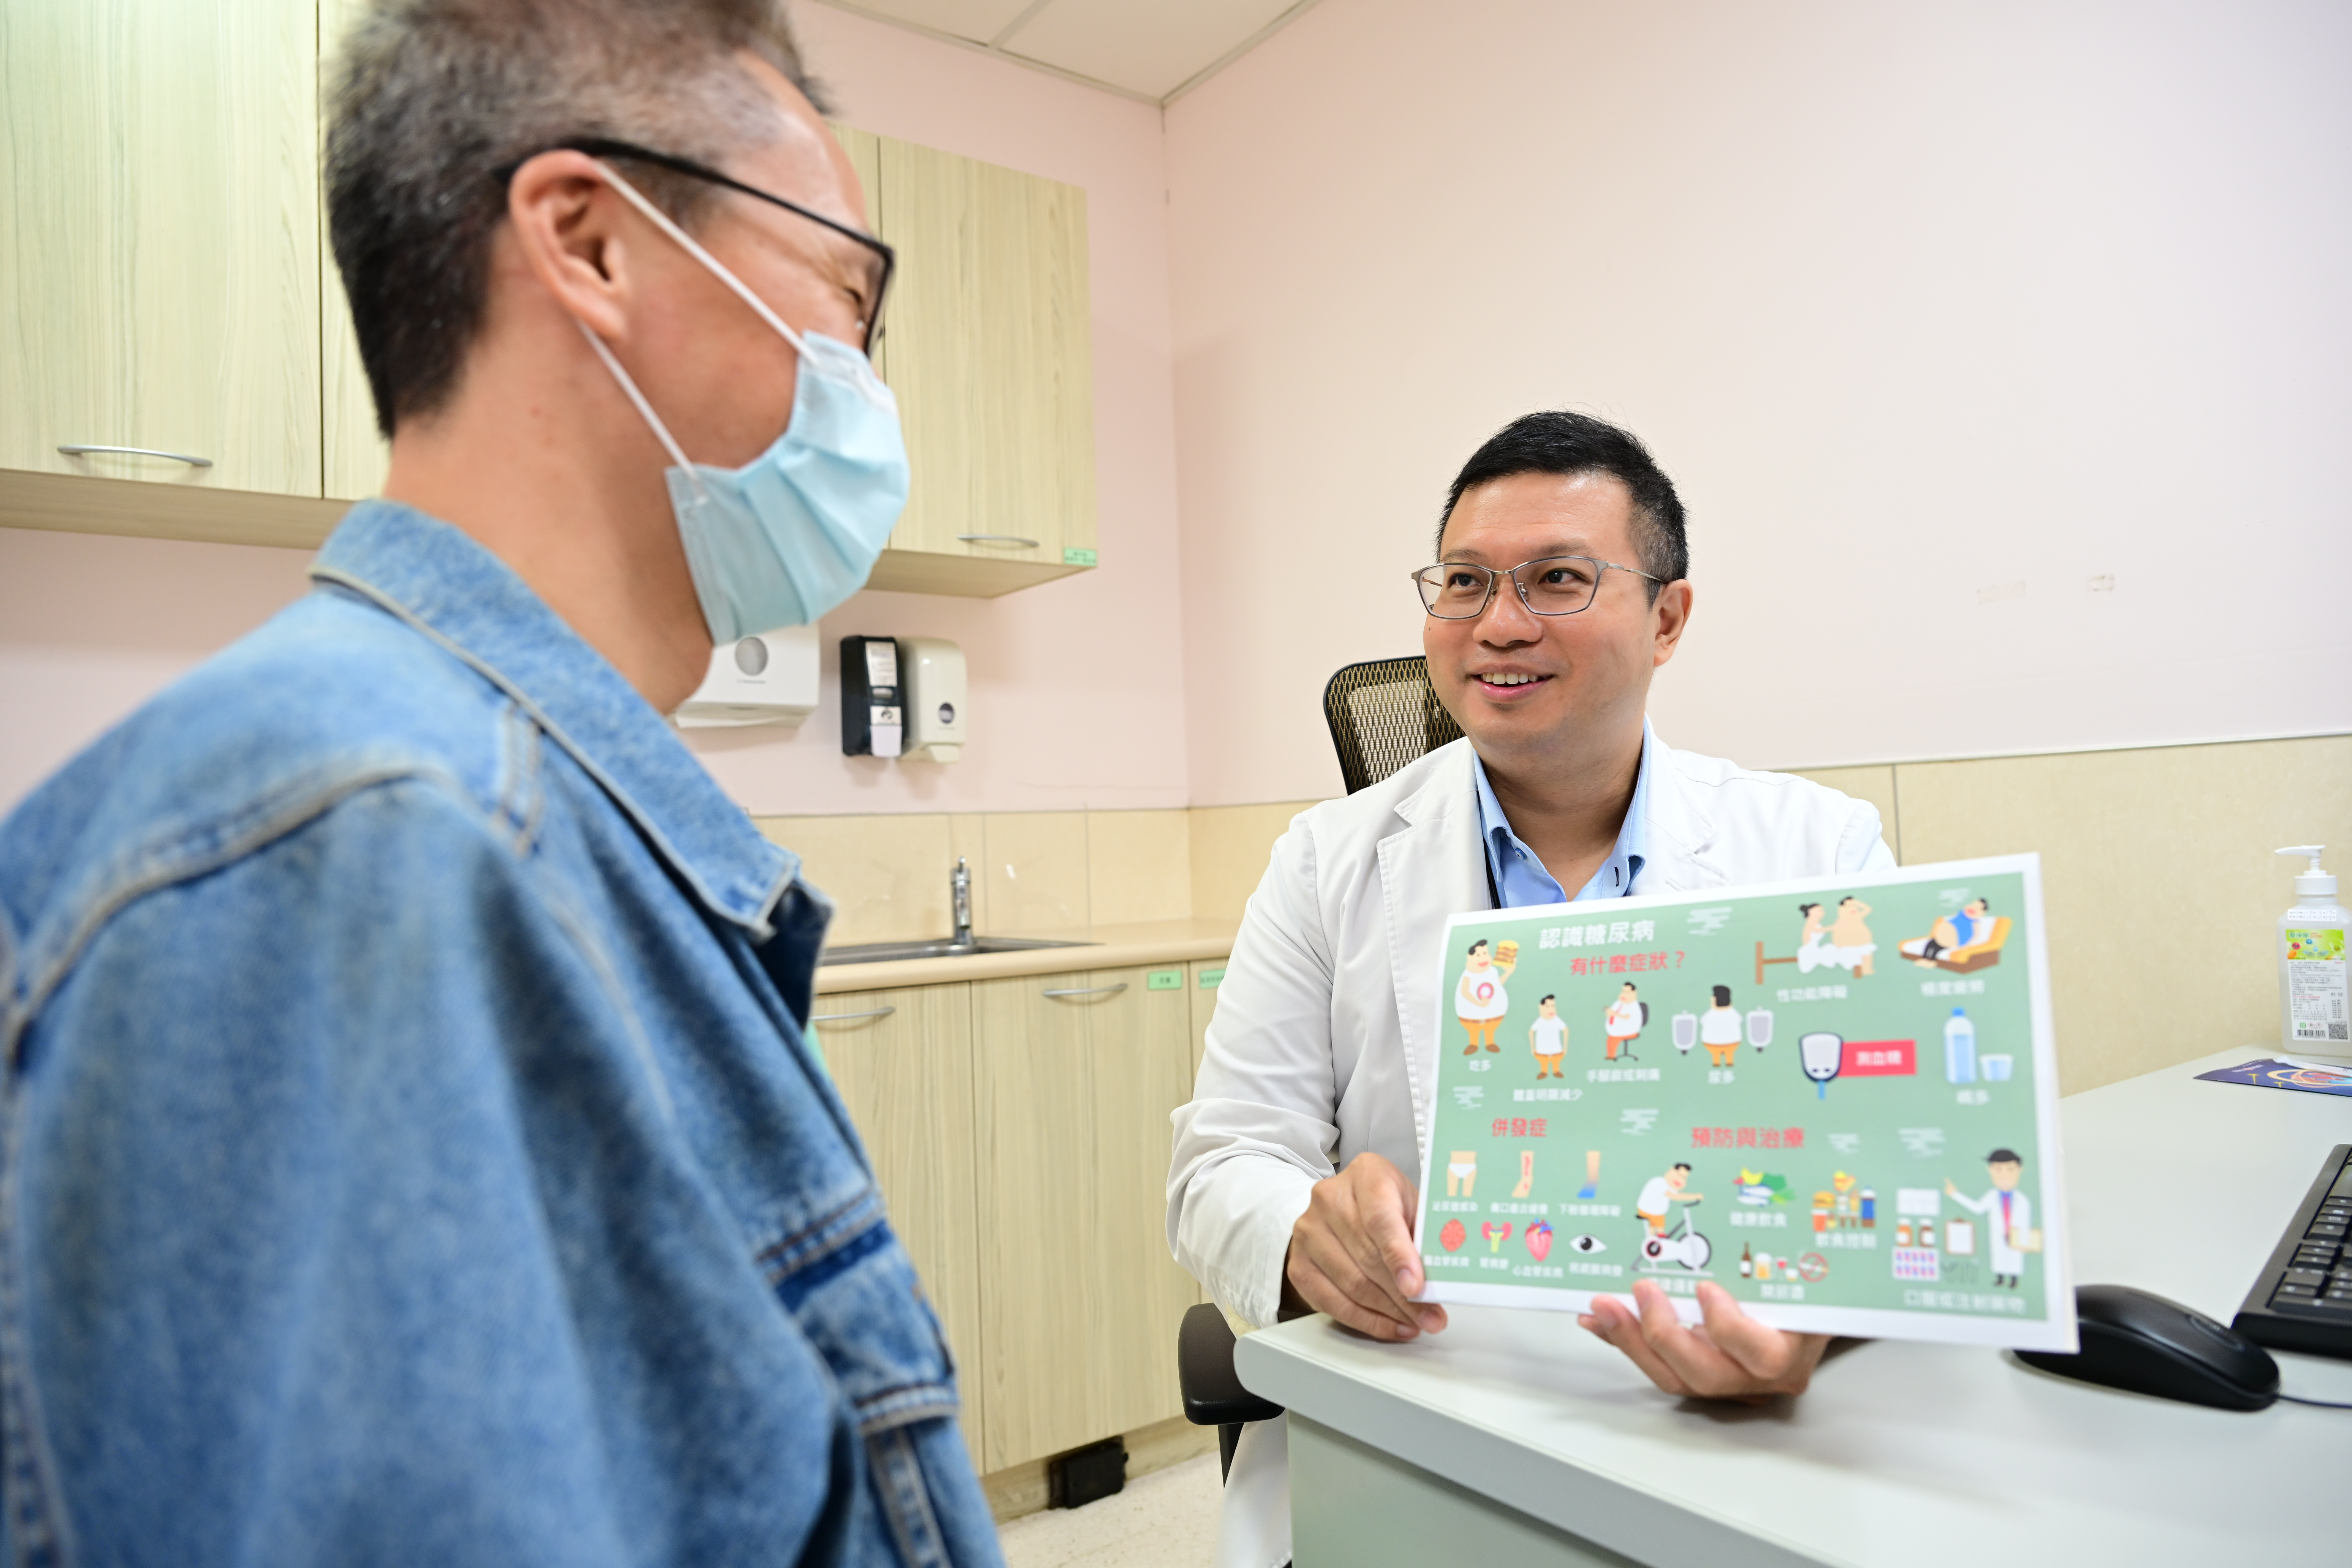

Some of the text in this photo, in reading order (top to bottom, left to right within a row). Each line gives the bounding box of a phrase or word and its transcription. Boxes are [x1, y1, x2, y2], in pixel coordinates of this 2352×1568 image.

[1539, 920, 1655, 949] 認識糖尿病
[1571, 951, 1685, 975] 有什麼症狀？
[1776, 985, 1847, 1002] 性功能障礙
[1856, 1050, 1902, 1065] 測血糖
[1469, 1059, 1491, 1072] 吃多
[1708, 1070, 1735, 1084] 尿多
[1513, 1088, 1582, 1102] 體重明顯減少
[1492, 1118, 1547, 1137] 併發症
[1692, 1127, 1804, 1148] 預防與治療
[1432, 1201, 1478, 1212] 泌尿道感染
[1729, 1211, 1786, 1227] 健康飲食
[1815, 1233, 1876, 1250] 飲食控制
[1424, 1255, 1469, 1268] 腦血管疾病
[1512, 1265, 1563, 1278] 心血管疾病
